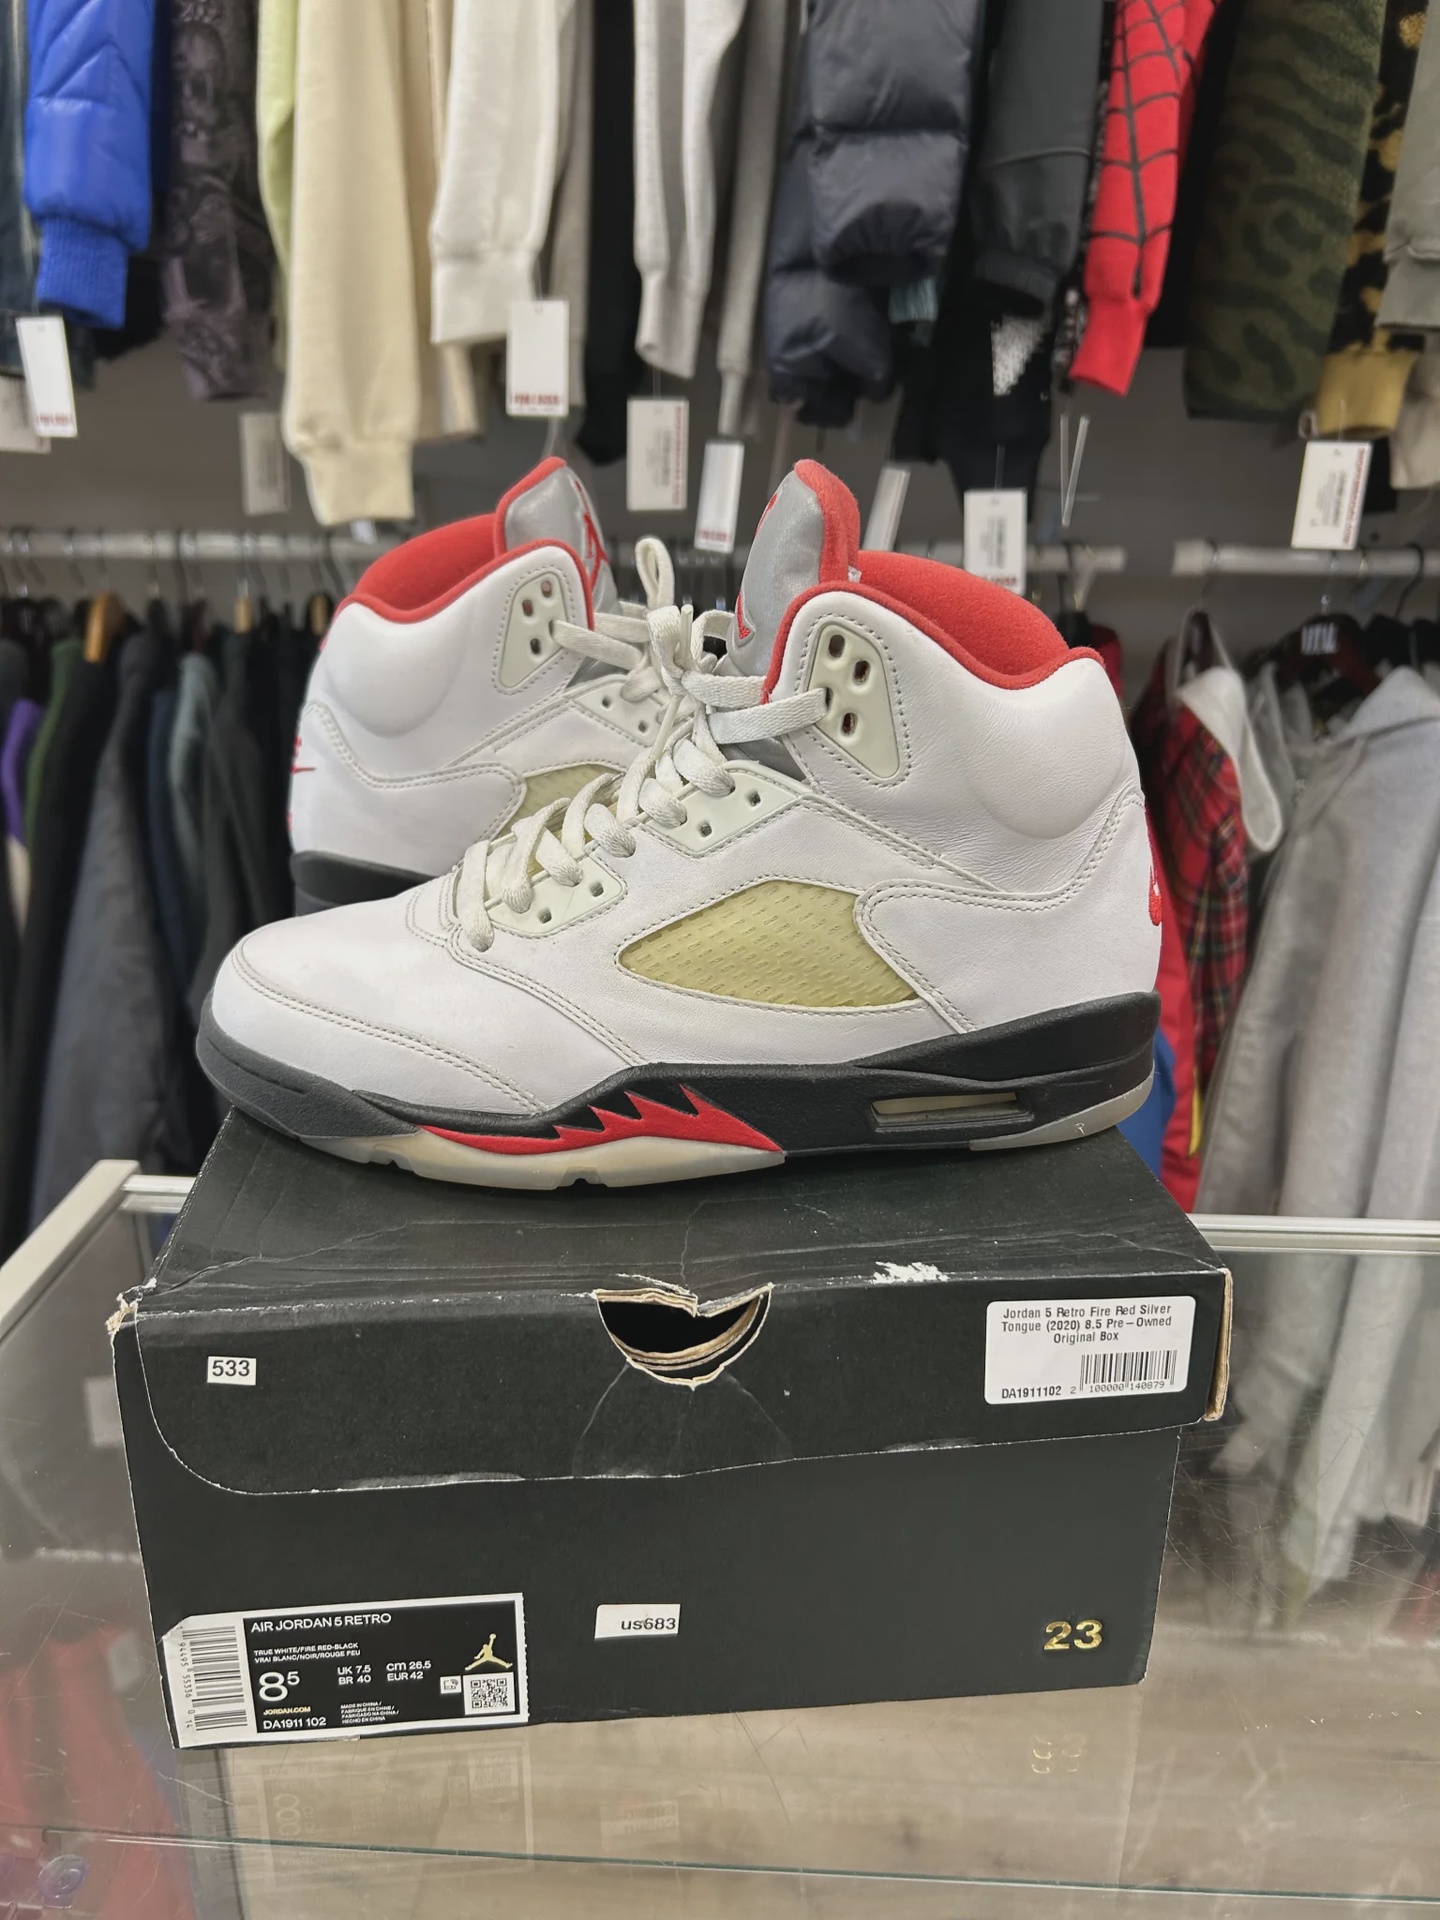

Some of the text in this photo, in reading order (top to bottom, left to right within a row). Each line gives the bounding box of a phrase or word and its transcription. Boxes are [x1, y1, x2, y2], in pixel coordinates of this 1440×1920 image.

[1003, 1303, 1172, 1319] Jordan 5 Retro Fire Red Silver
[1001, 1320, 1041, 1334] Tongue
[1046, 1319, 1081, 1332] (2020)
[1085, 1318, 1102, 1330] 8.5
[1053, 1331, 1119, 1345] Original Box
[212, 1359, 250, 1377] 533
[1001, 1380, 1165, 1399] DA1911102 2 100000 140879
[251, 1612, 392, 1633] AIR JORDAN 5 RETRO
[621, 1617, 676, 1631] us683
[1043, 1619, 1103, 1650] 23
[253, 1642, 359, 1656] TRUE WHITE/FIRE RED-BLACK
[272, 1651, 345, 1662] BLANC/NOIR/ROUGE
[337, 1664, 372, 1675] UK 7.5
[386, 1660, 432, 1672] cm 26.5
[338, 1674, 372, 1685] BR 40
[387, 1671, 424, 1682] EUR 42
[263, 1706, 311, 1716] JORDAN.COM
[263, 1717, 327, 1730] DA1911 102
